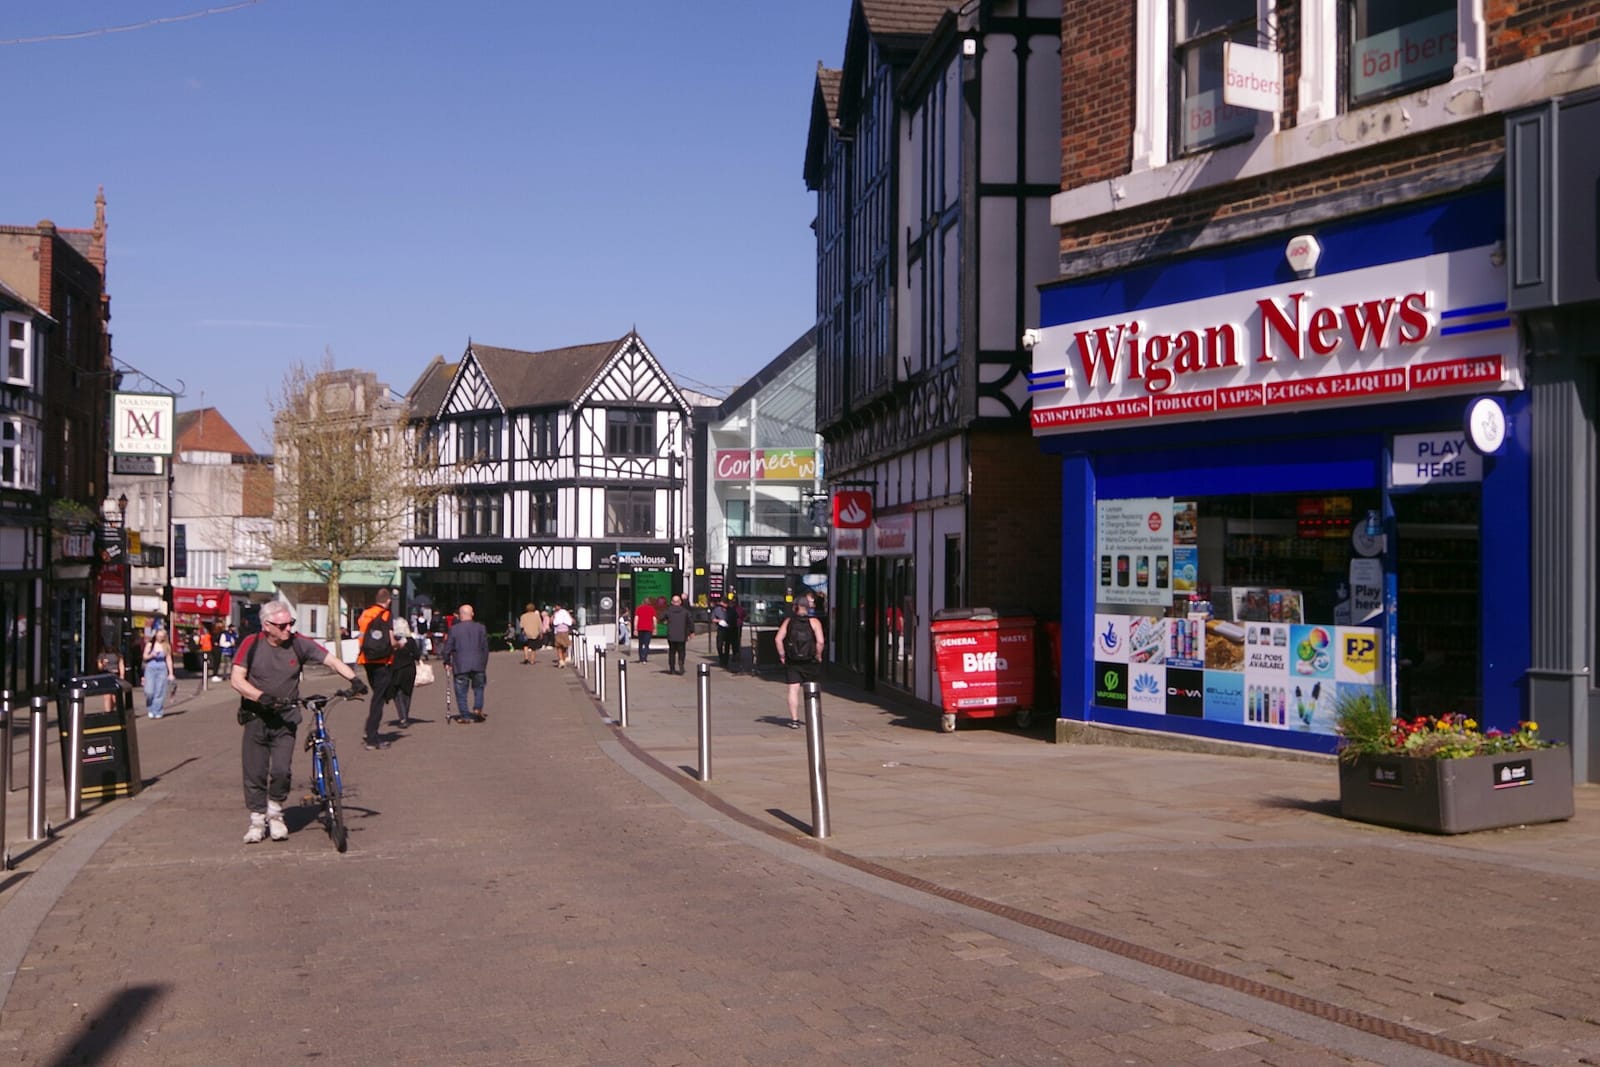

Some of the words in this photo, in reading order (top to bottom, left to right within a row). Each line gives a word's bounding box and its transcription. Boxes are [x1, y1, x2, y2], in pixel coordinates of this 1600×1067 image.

[1363, 32, 1457, 77] barbers
[1226, 71, 1281, 96] barbers
[1073, 320, 1243, 393] Wigan
[1256, 291, 1431, 363] News
[1415, 360, 1499, 383] LOTTERY
[1267, 384, 1314, 400] E-CIGS
[1316, 382, 1327, 395] &
[1331, 372, 1405, 392] E-LIQUID
[1155, 394, 1213, 411] TOBACCO
[1219, 390, 1262, 405] VAPES
[1033, 407, 1103, 424] NEWSPAPERS
[1105, 405, 1114, 417] &
[1116, 401, 1149, 415] MAGS
[1418, 440, 1466, 457] PLAY
[718, 450, 798, 477] Connect
[1417, 461, 1467, 478] HERE
[1355, 584, 1381, 599] Play
[1355, 598, 1381, 609] here
[941, 637, 977, 647] GENERAL
[1000, 635, 1026, 643] WASTE
[962, 651, 1009, 673] Biffa
[1249, 661, 1285, 670] AVAILABLE
[1167, 687, 1202, 698] OXVA
